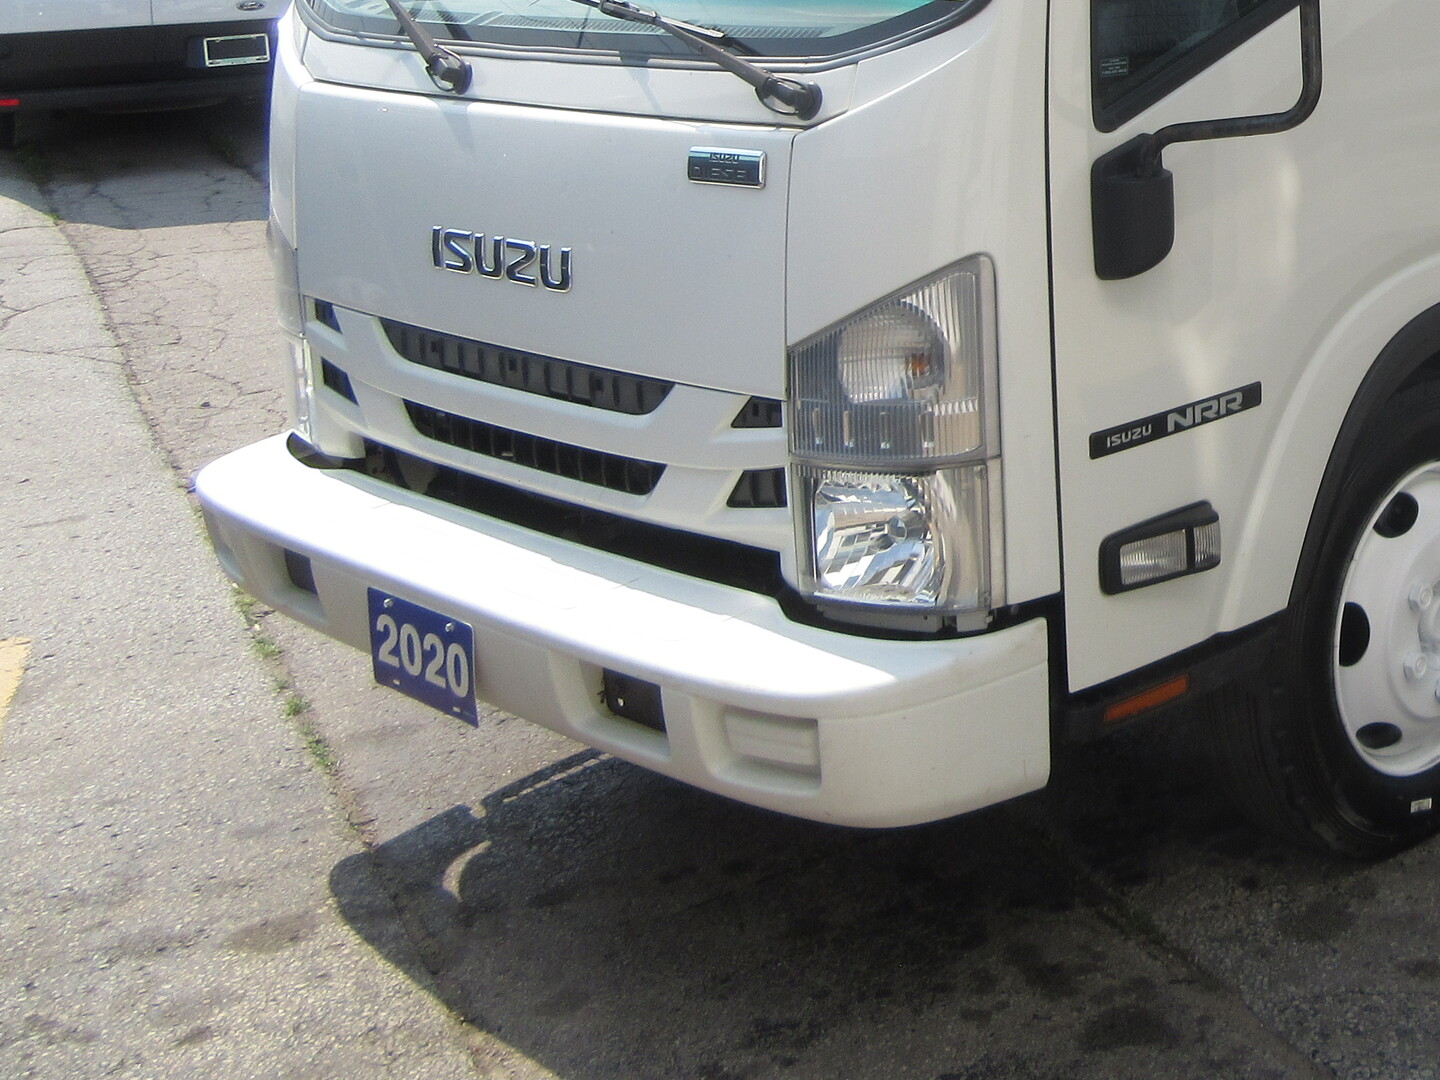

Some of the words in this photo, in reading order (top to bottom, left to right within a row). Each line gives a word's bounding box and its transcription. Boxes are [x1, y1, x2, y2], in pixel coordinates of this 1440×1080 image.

[431, 225, 573, 293] ISUZU
[1106, 423, 1152, 448] ISUZU
[1167, 391, 1243, 433] NRR
[376, 613, 469, 698] 2020
